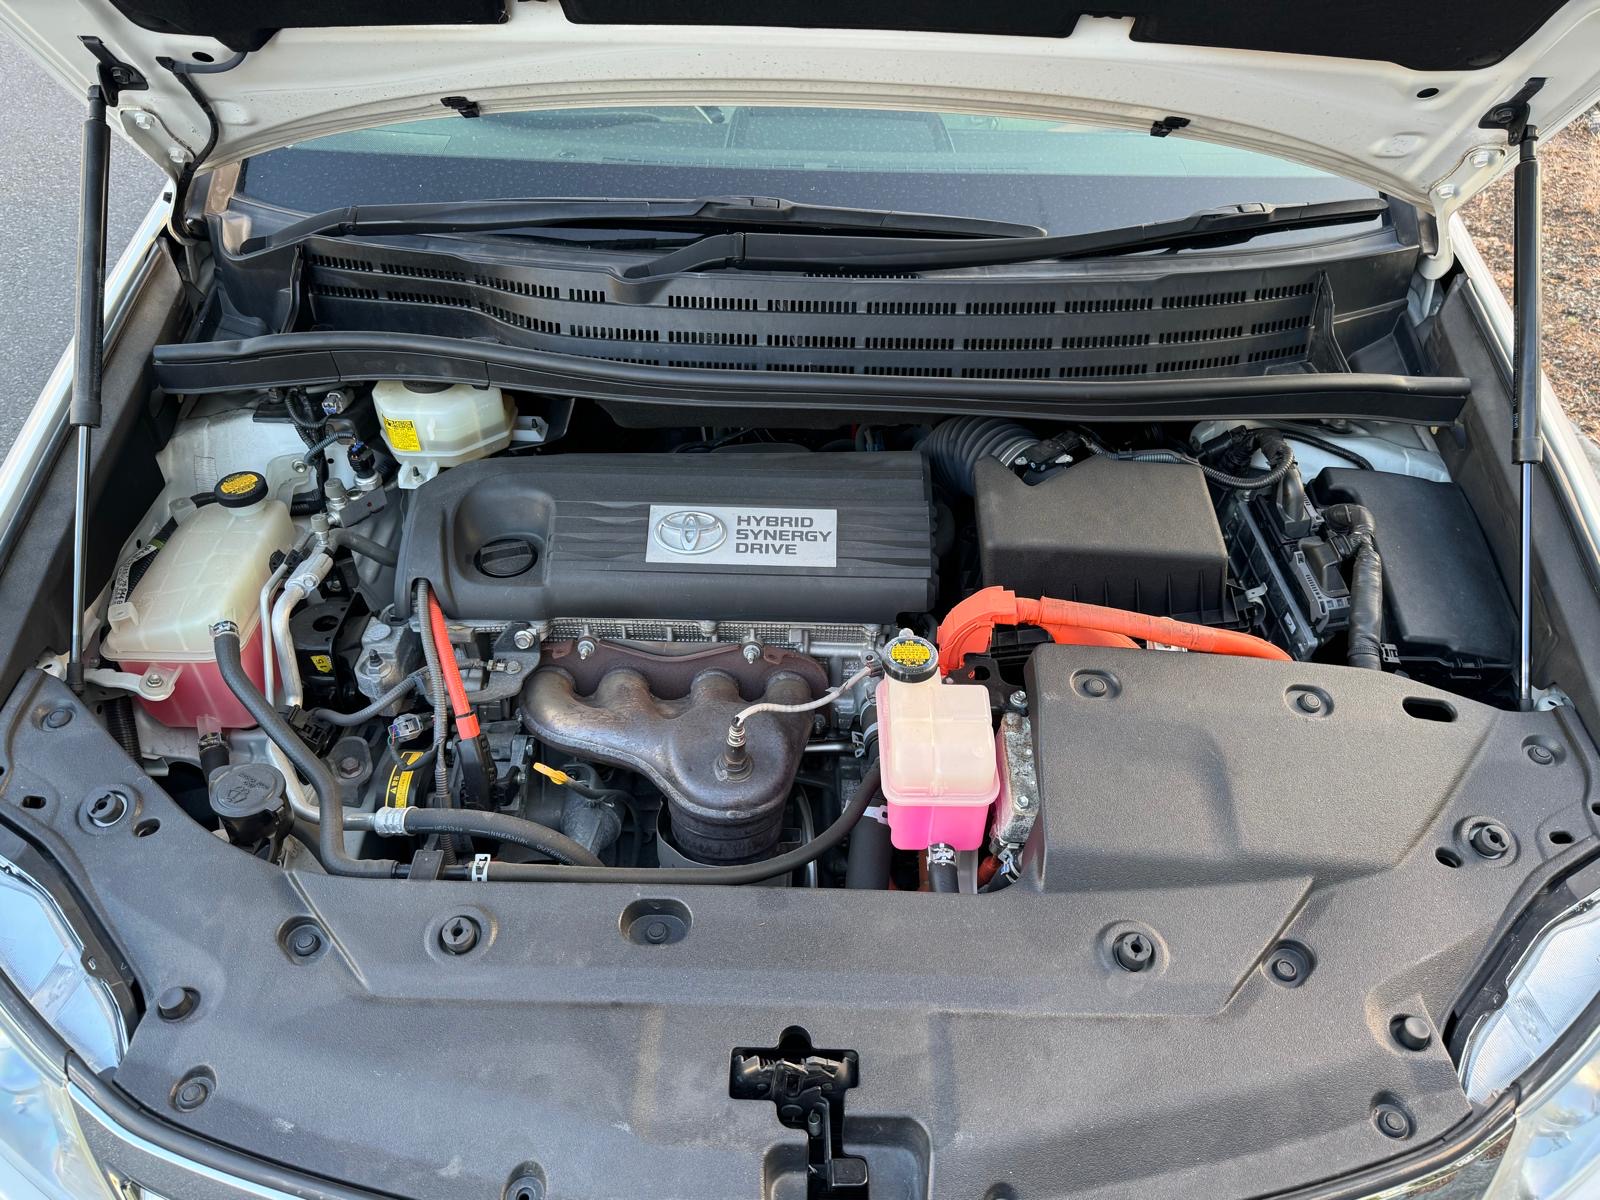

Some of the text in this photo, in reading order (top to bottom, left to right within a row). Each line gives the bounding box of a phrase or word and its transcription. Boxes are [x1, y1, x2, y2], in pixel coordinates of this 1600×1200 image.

[736, 515, 814, 528] HYBRID
[735, 529, 832, 542] SYNERGY
[735, 542, 797, 555] DRIVE
